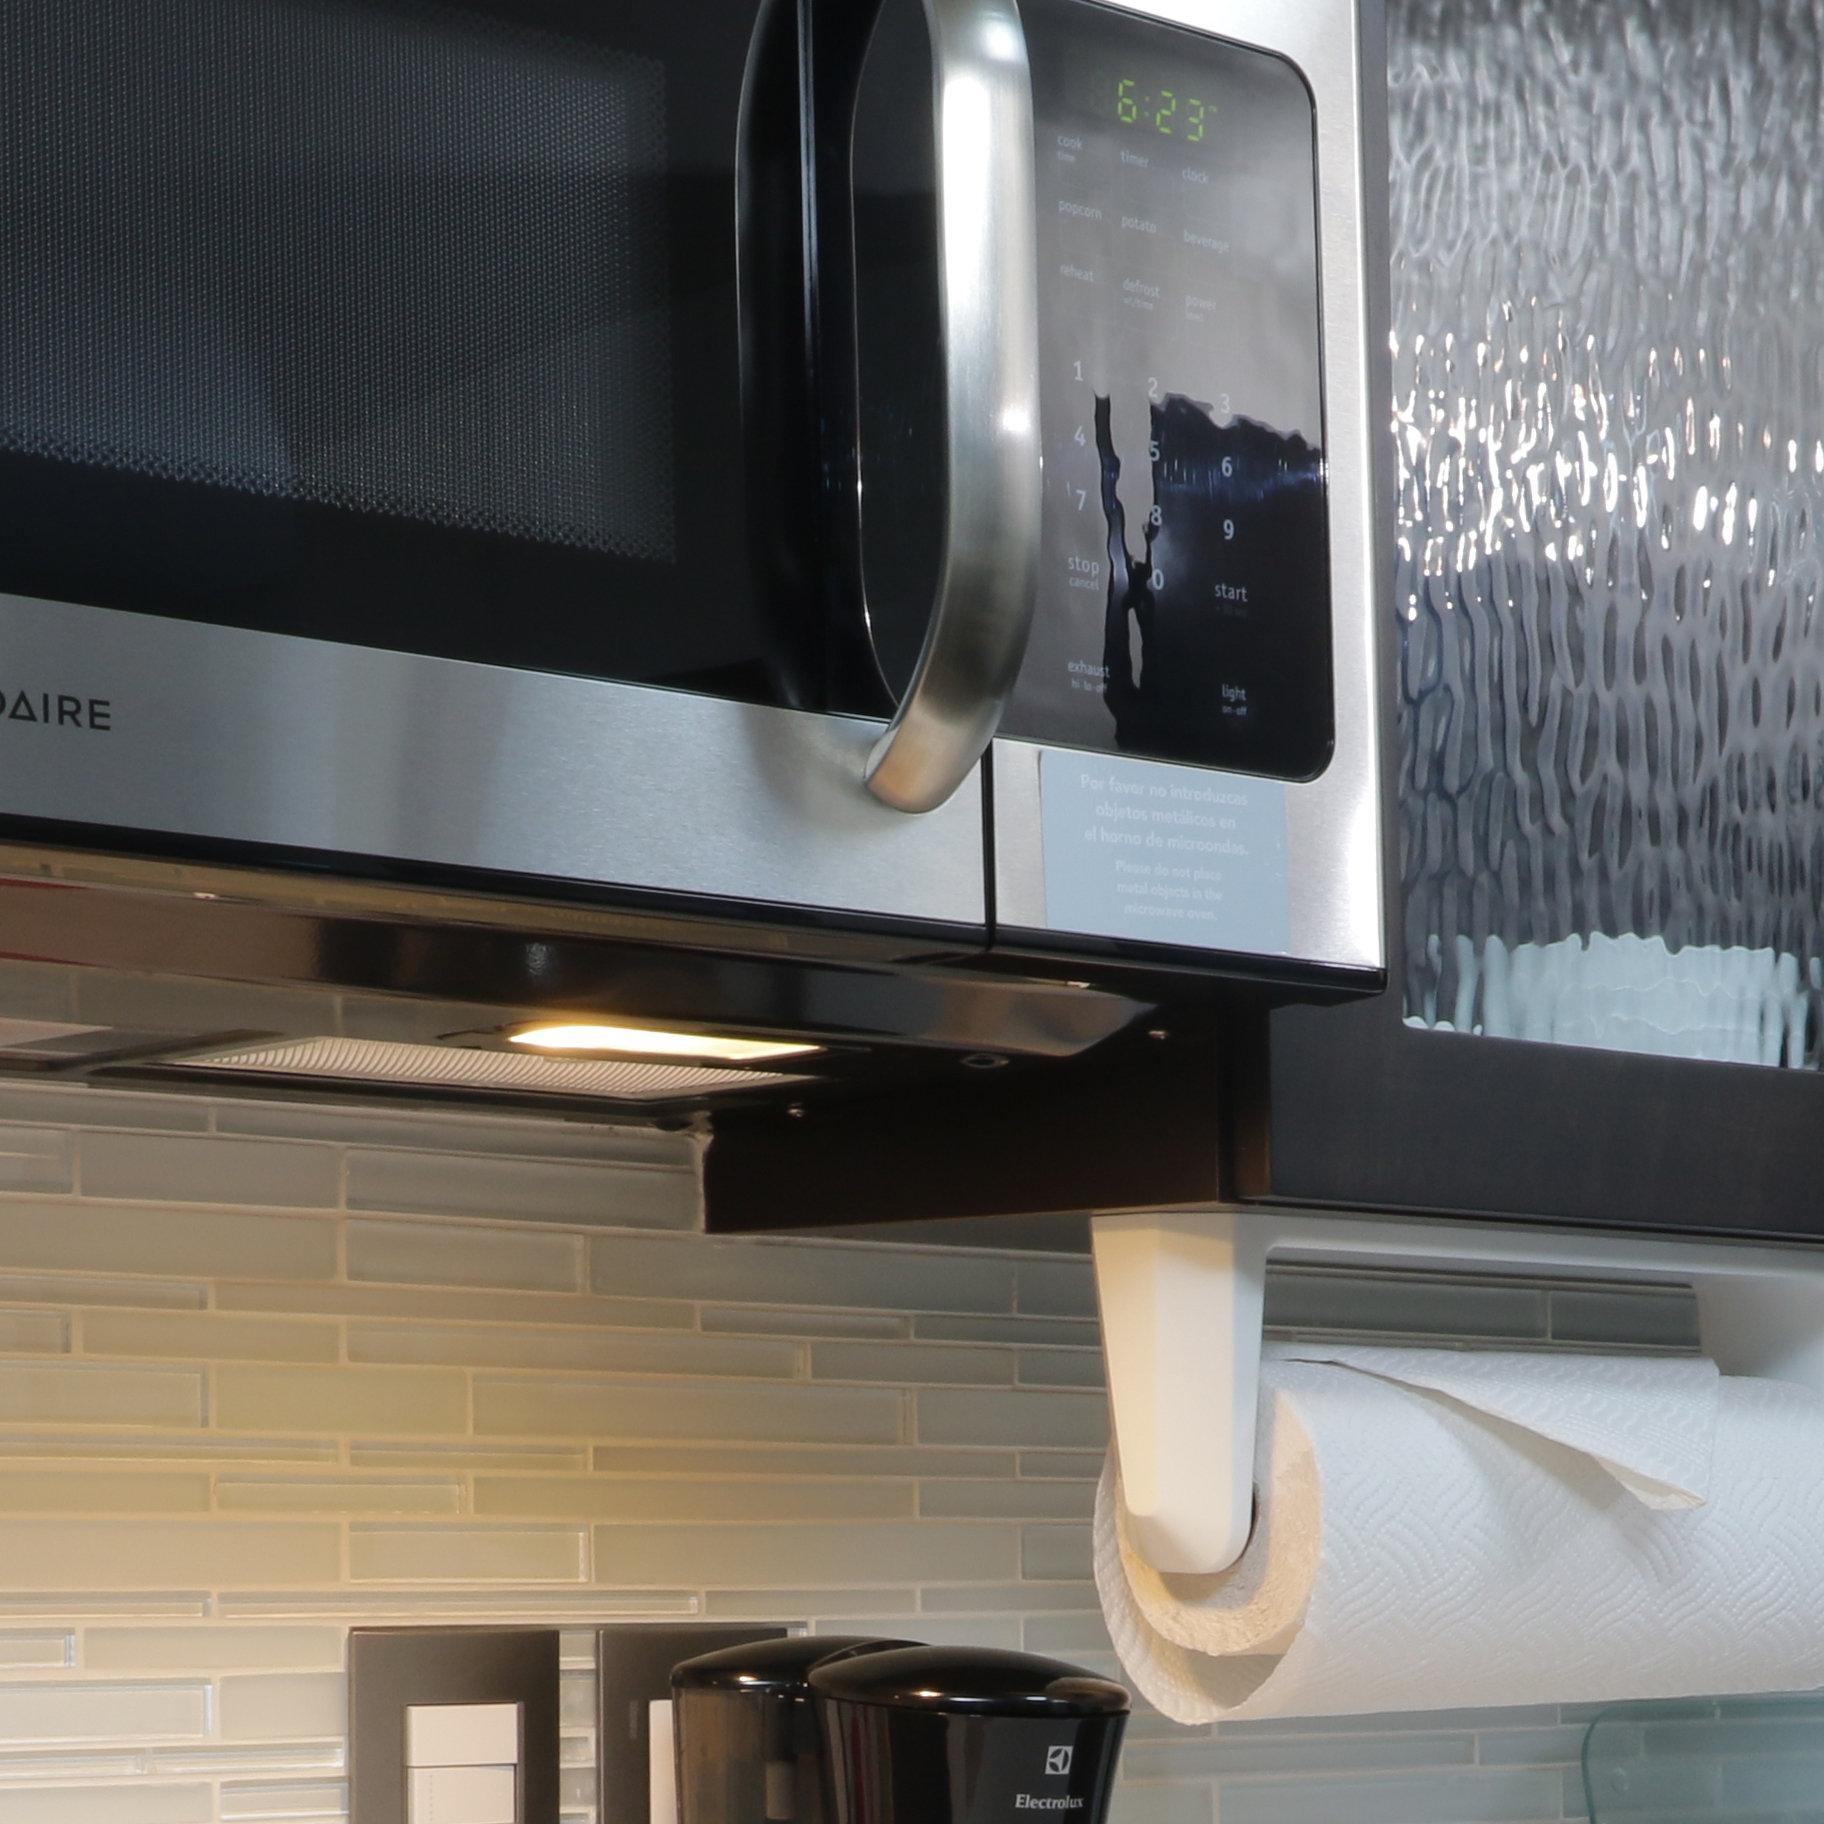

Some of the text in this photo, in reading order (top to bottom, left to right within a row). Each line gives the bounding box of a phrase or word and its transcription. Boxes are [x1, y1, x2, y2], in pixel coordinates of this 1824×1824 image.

[1118, 79, 1205, 142] 6:23
[1057, 135, 1083, 151] cook
[1120, 150, 1150, 168] timer
[1182, 168, 1209, 184] clock
[1058, 200, 1102, 220] popcorn
[1121, 215, 1157, 234] potato
[1184, 230, 1232, 254] beverage
[1060, 264, 1094, 282] reheat
[1122, 278, 1160, 298] defrost
[1073, 360, 1083, 382] 1
[1148, 377, 1158, 399] 2
[1220, 392, 1230, 414] 3
[1074, 425, 1086, 446] 4
[1149, 441, 1160, 462] 5
[1221, 456, 1232, 477] 6
[1076, 489, 1086, 511] 7
[1151, 505, 1162, 526] 8
[1223, 519, 1234, 540] 9
[1068, 556, 1100, 577] stop
[1069, 577, 1100, 591] cancel
[1152, 569, 1164, 590] 0
[1214, 582, 1248, 602] start
[1067, 660, 1110, 678] exhaust
[1222, 683, 1247, 702] light
[1080, 773, 1249, 806] Por favor no introduzcas
[1095, 801, 1236, 830] objetos metálicos en
[1084, 825, 1250, 856] el horno de microondas.
[1115, 859, 1222, 882] Please do not place
[1116, 881, 1223, 901] metal objects in the
[1124, 904, 1184, 919] microwave
[1015, 1793, 1084, 1810] Electrolux
